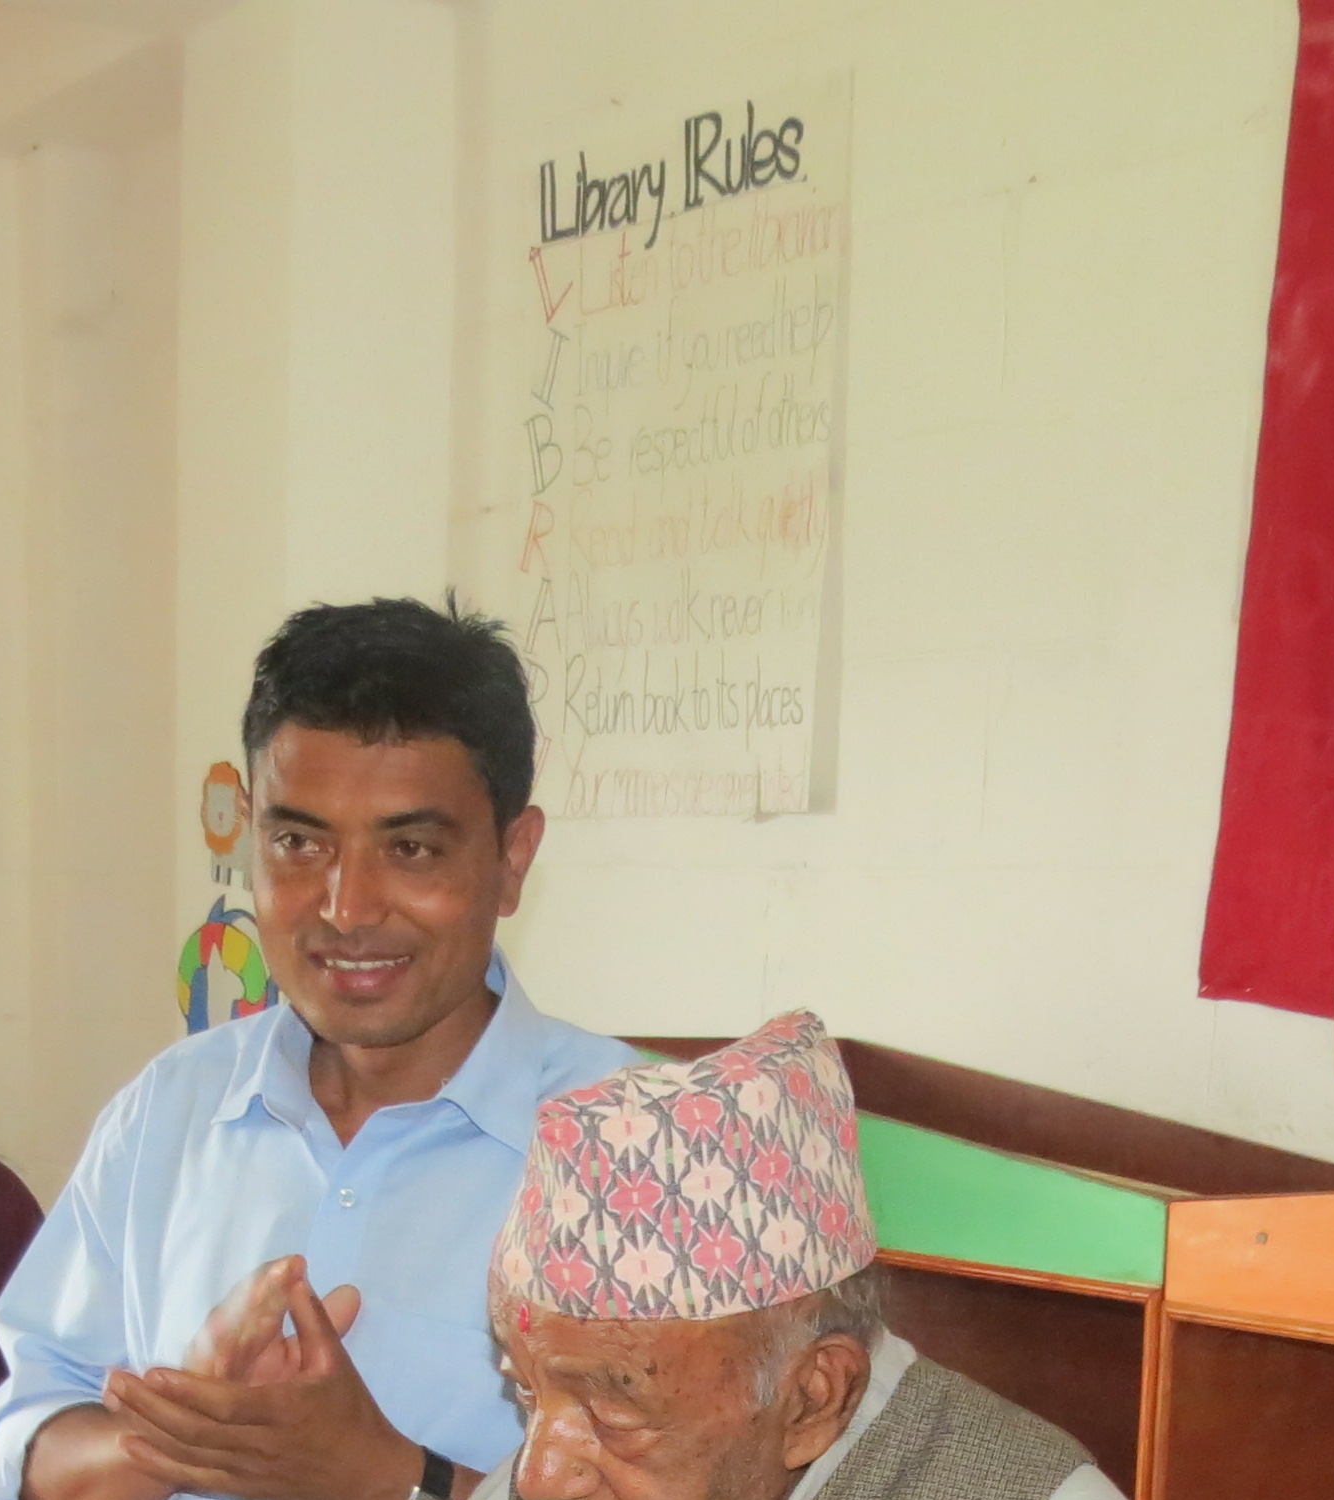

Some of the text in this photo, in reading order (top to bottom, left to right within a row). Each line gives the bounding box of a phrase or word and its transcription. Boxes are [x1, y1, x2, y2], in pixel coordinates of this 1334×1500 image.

[540, 150, 666, 251] Library
[524, 413, 564, 497] B
[520, 500, 556, 578] R
[524, 576, 562, 655] A
[746, 655, 805, 752] places
